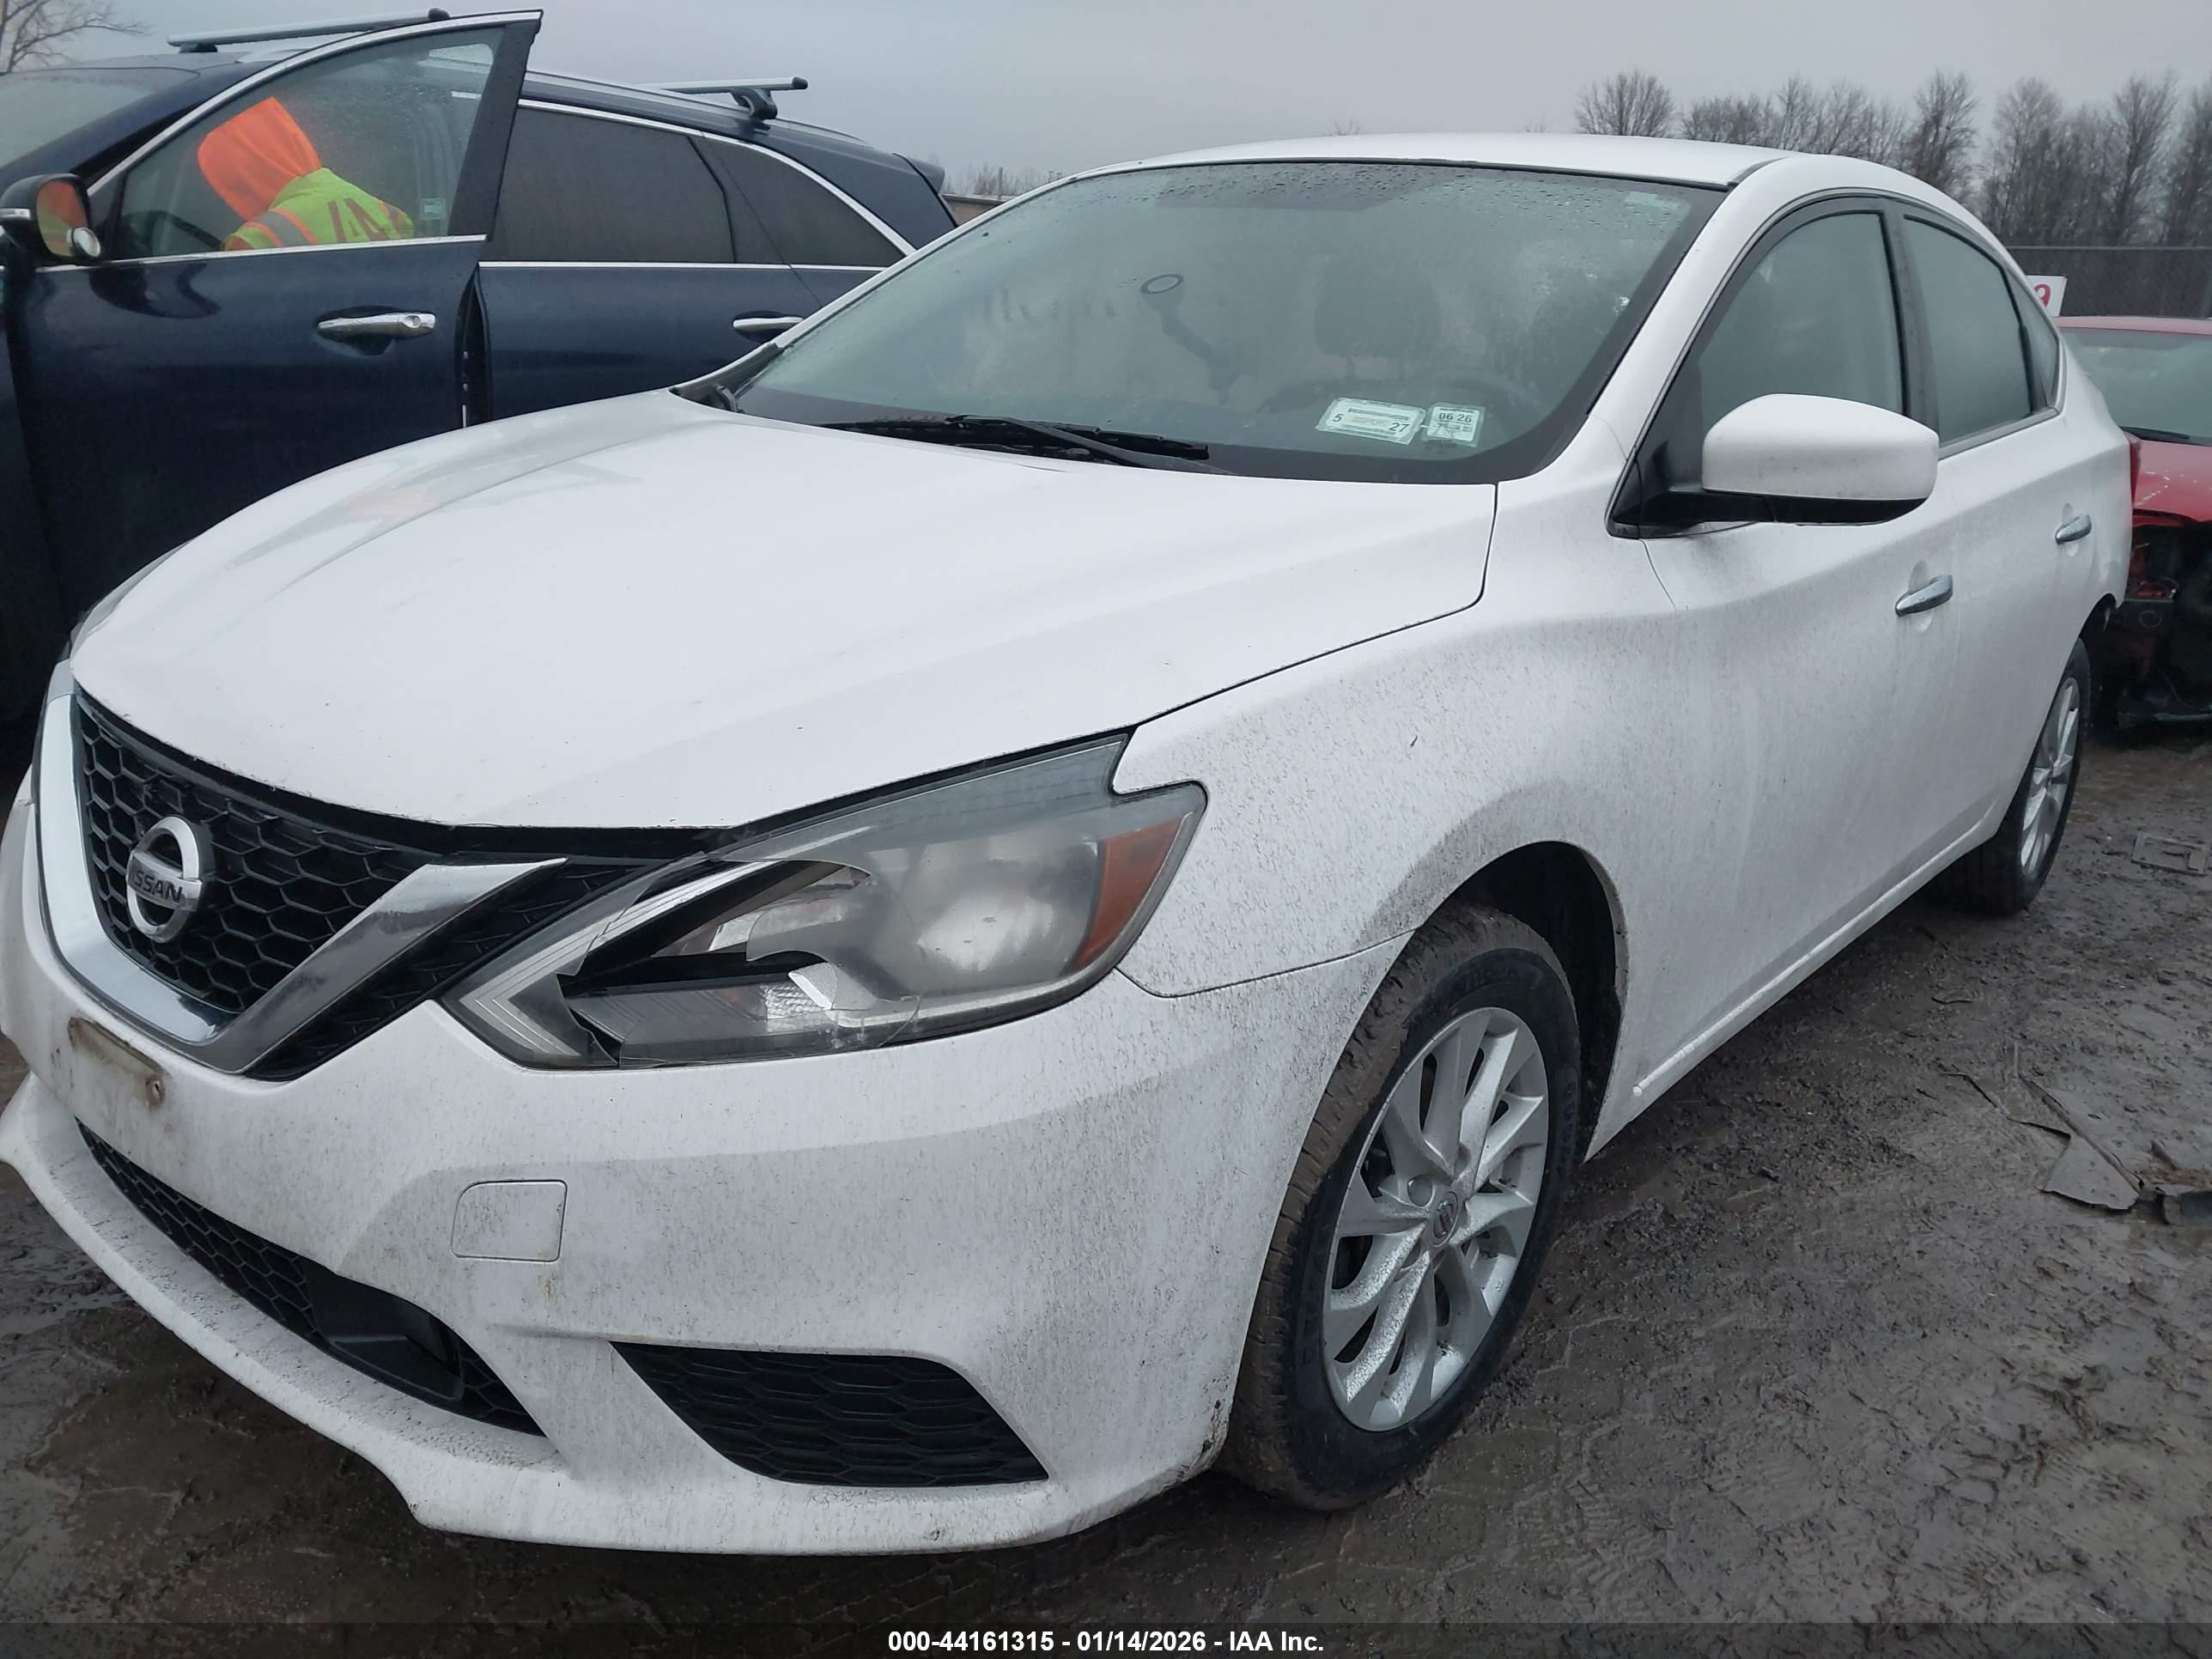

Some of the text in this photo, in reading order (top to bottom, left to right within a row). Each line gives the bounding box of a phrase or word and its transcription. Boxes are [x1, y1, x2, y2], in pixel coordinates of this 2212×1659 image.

[1332, 413, 1345, 422] 5
[1438, 412, 1454, 421] 06
[1388, 422, 1410, 433] 27
